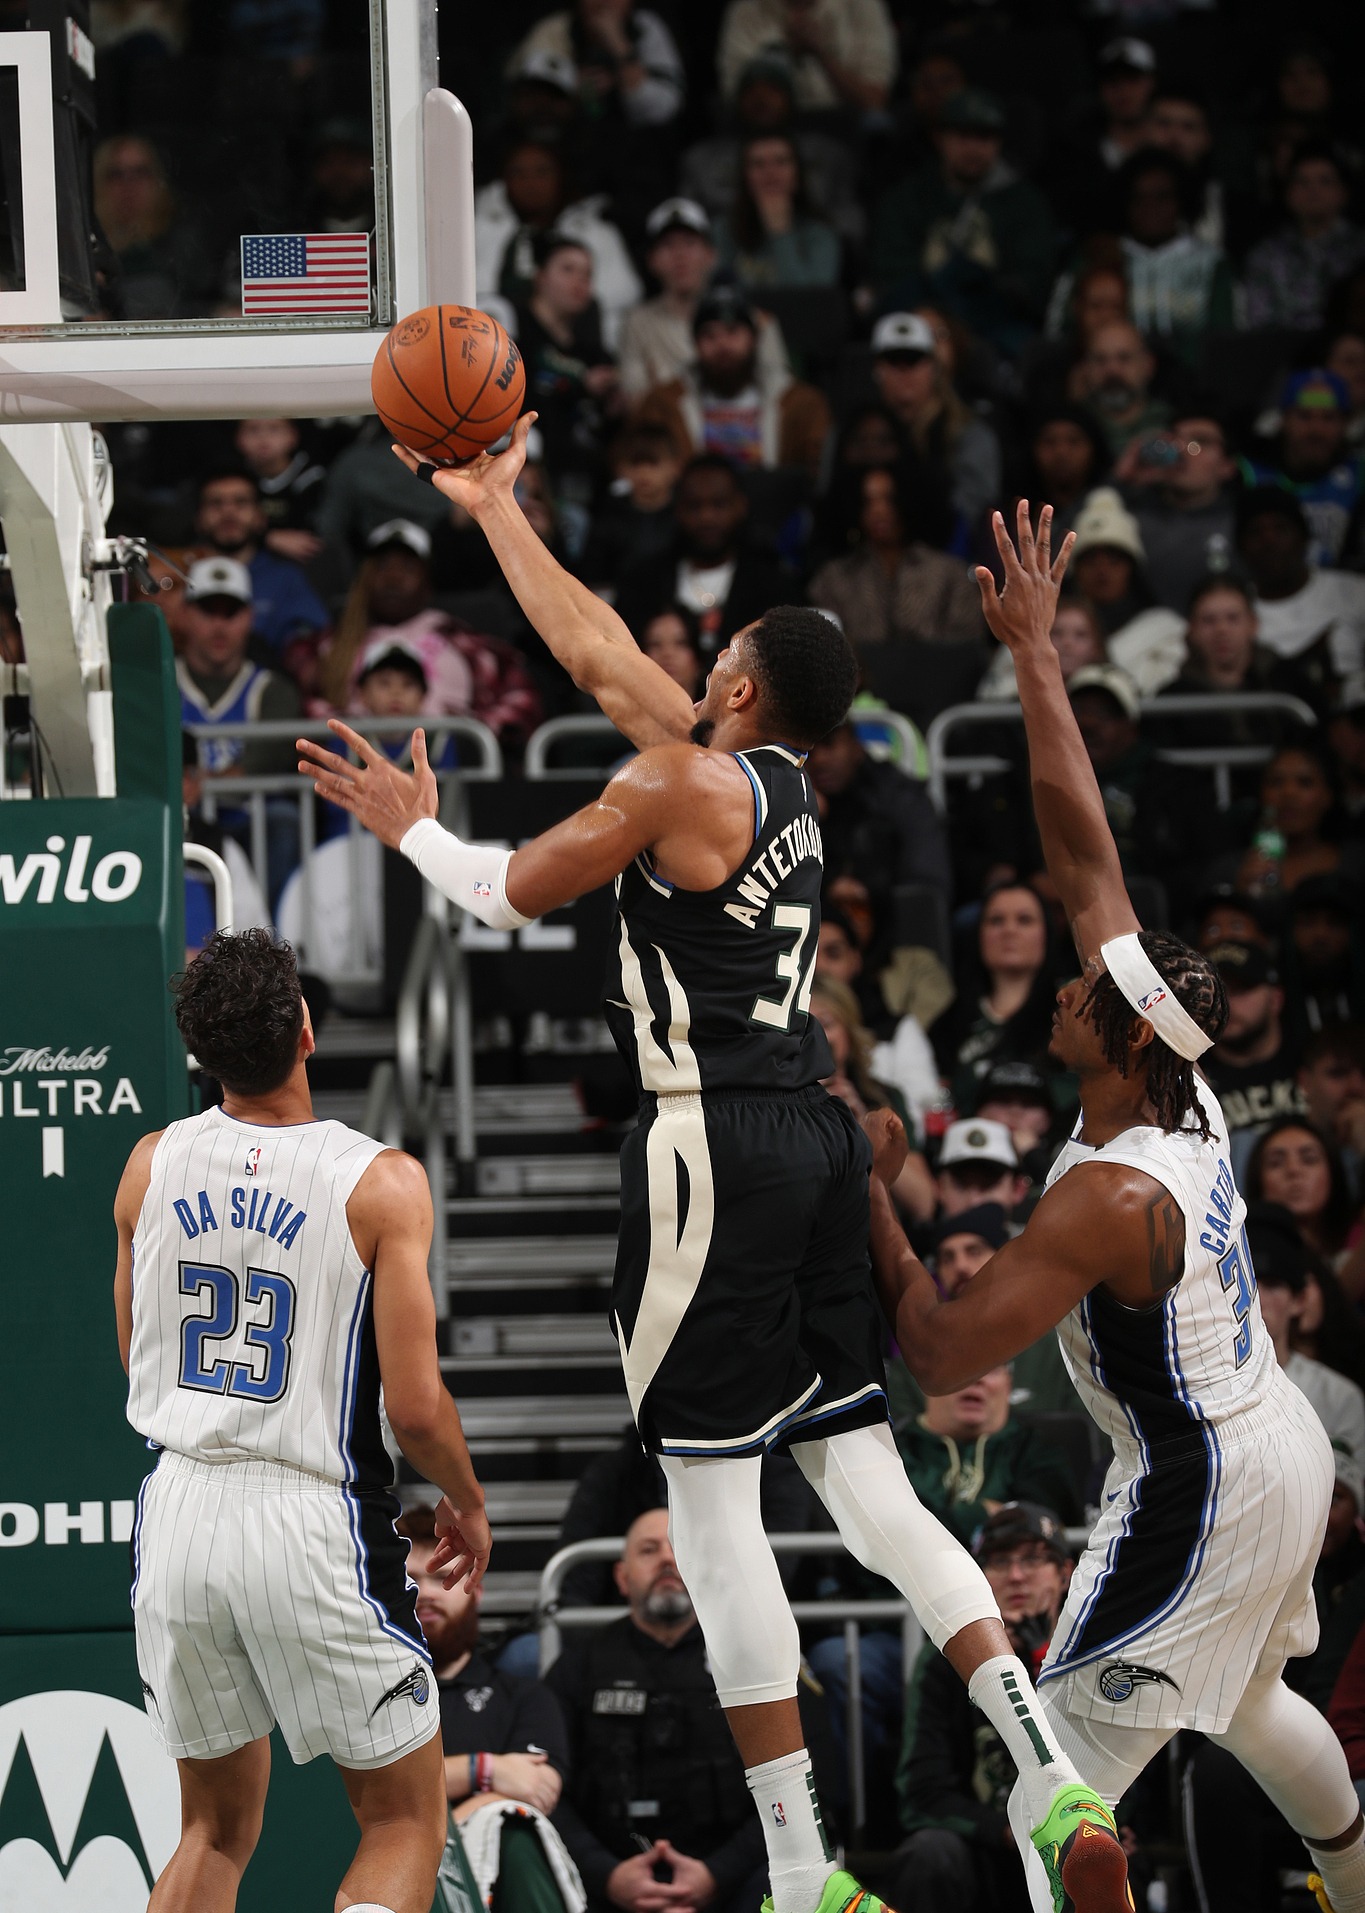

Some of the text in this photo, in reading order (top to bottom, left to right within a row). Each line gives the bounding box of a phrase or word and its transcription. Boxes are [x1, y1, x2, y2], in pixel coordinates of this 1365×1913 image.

[723, 813, 824, 930] ANTETOKOU
[0, 1045, 112, 1076] Michelob
[0, 1077, 143, 1117] LTRA
[172, 1187, 307, 1251] DA SILVA
[177, 1260, 297, 1404] 23
